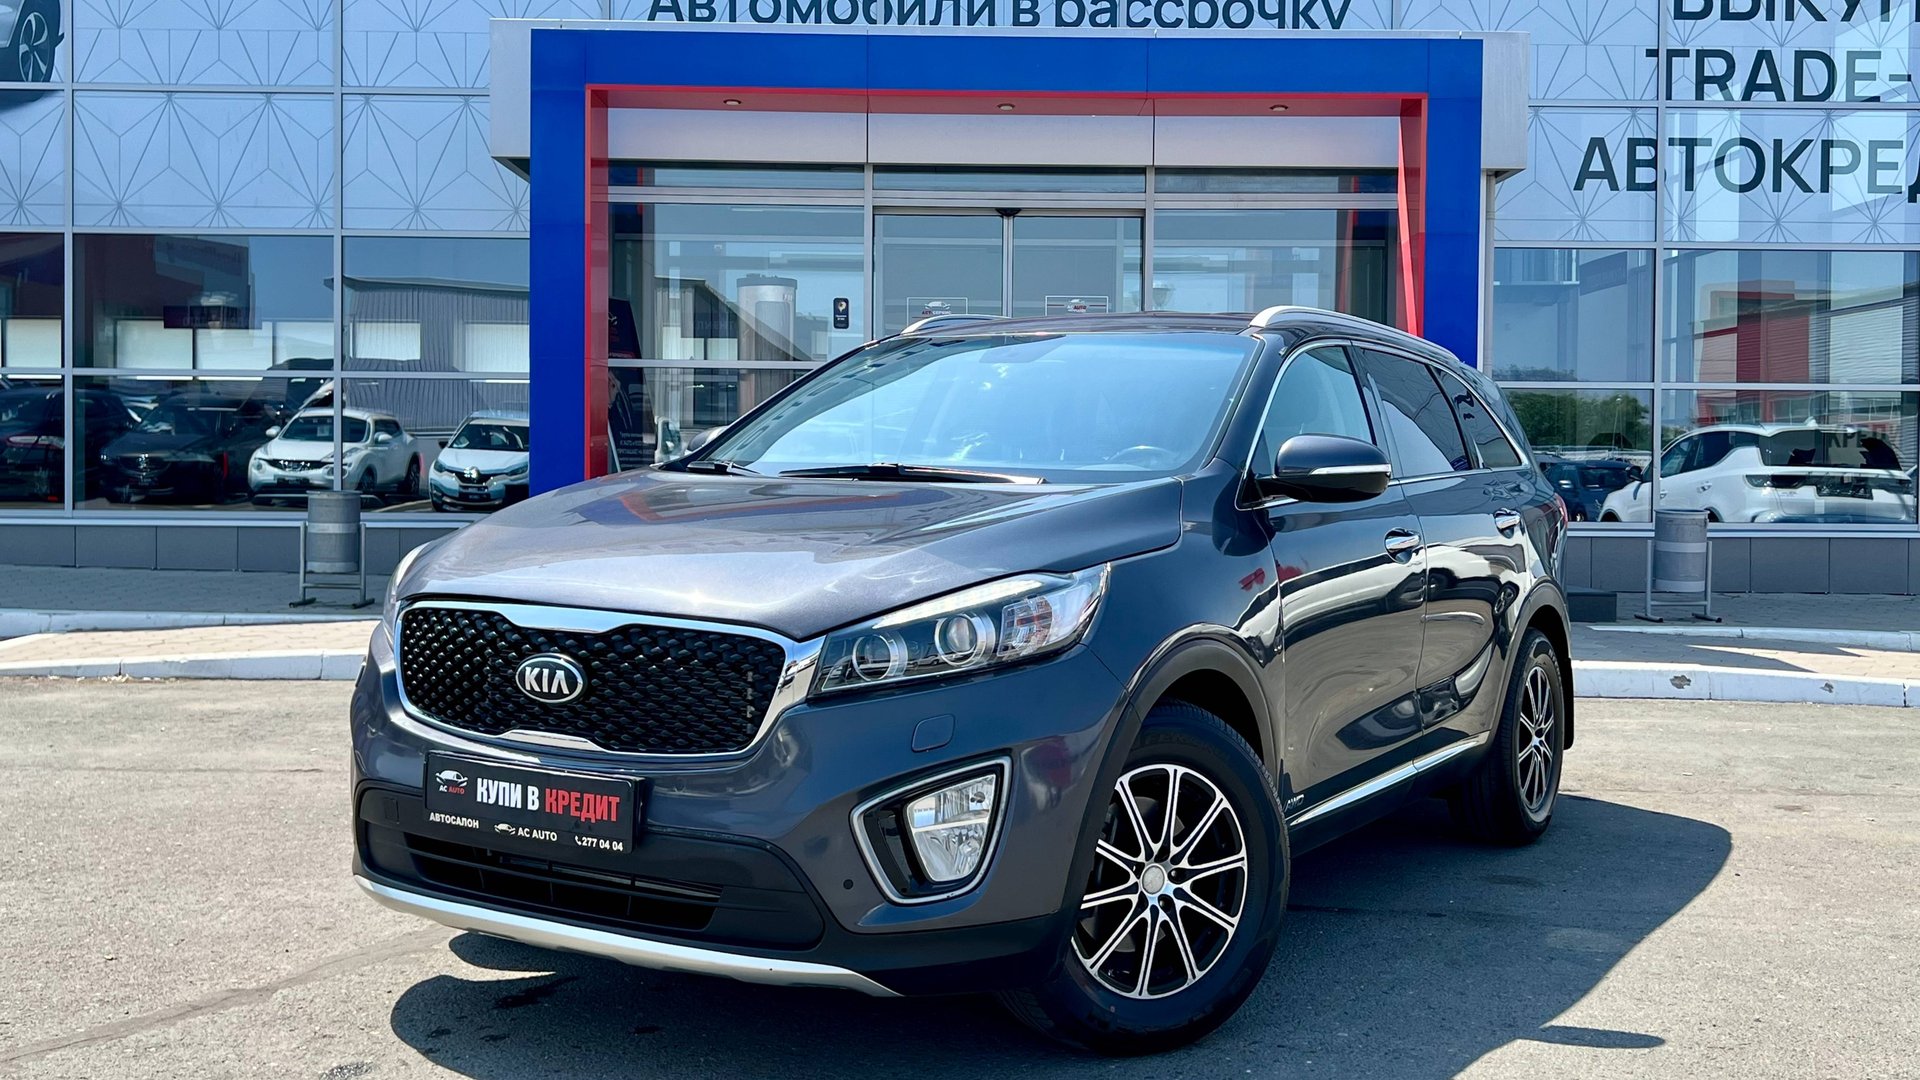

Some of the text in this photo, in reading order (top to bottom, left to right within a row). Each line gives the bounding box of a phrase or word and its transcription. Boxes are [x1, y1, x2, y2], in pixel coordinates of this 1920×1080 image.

[1573, 137, 1920, 203] АВТОКРЕ
[525, 667, 570, 695] KIA
[448, 786, 465, 795] AUTO
[476, 777, 620, 824] КУПИ В КРЕДИТ
[429, 812, 480, 829] АВТОСАЛОН
[517, 827, 558, 842] AC AUTO
[582, 836, 624, 852] 277 04 04
